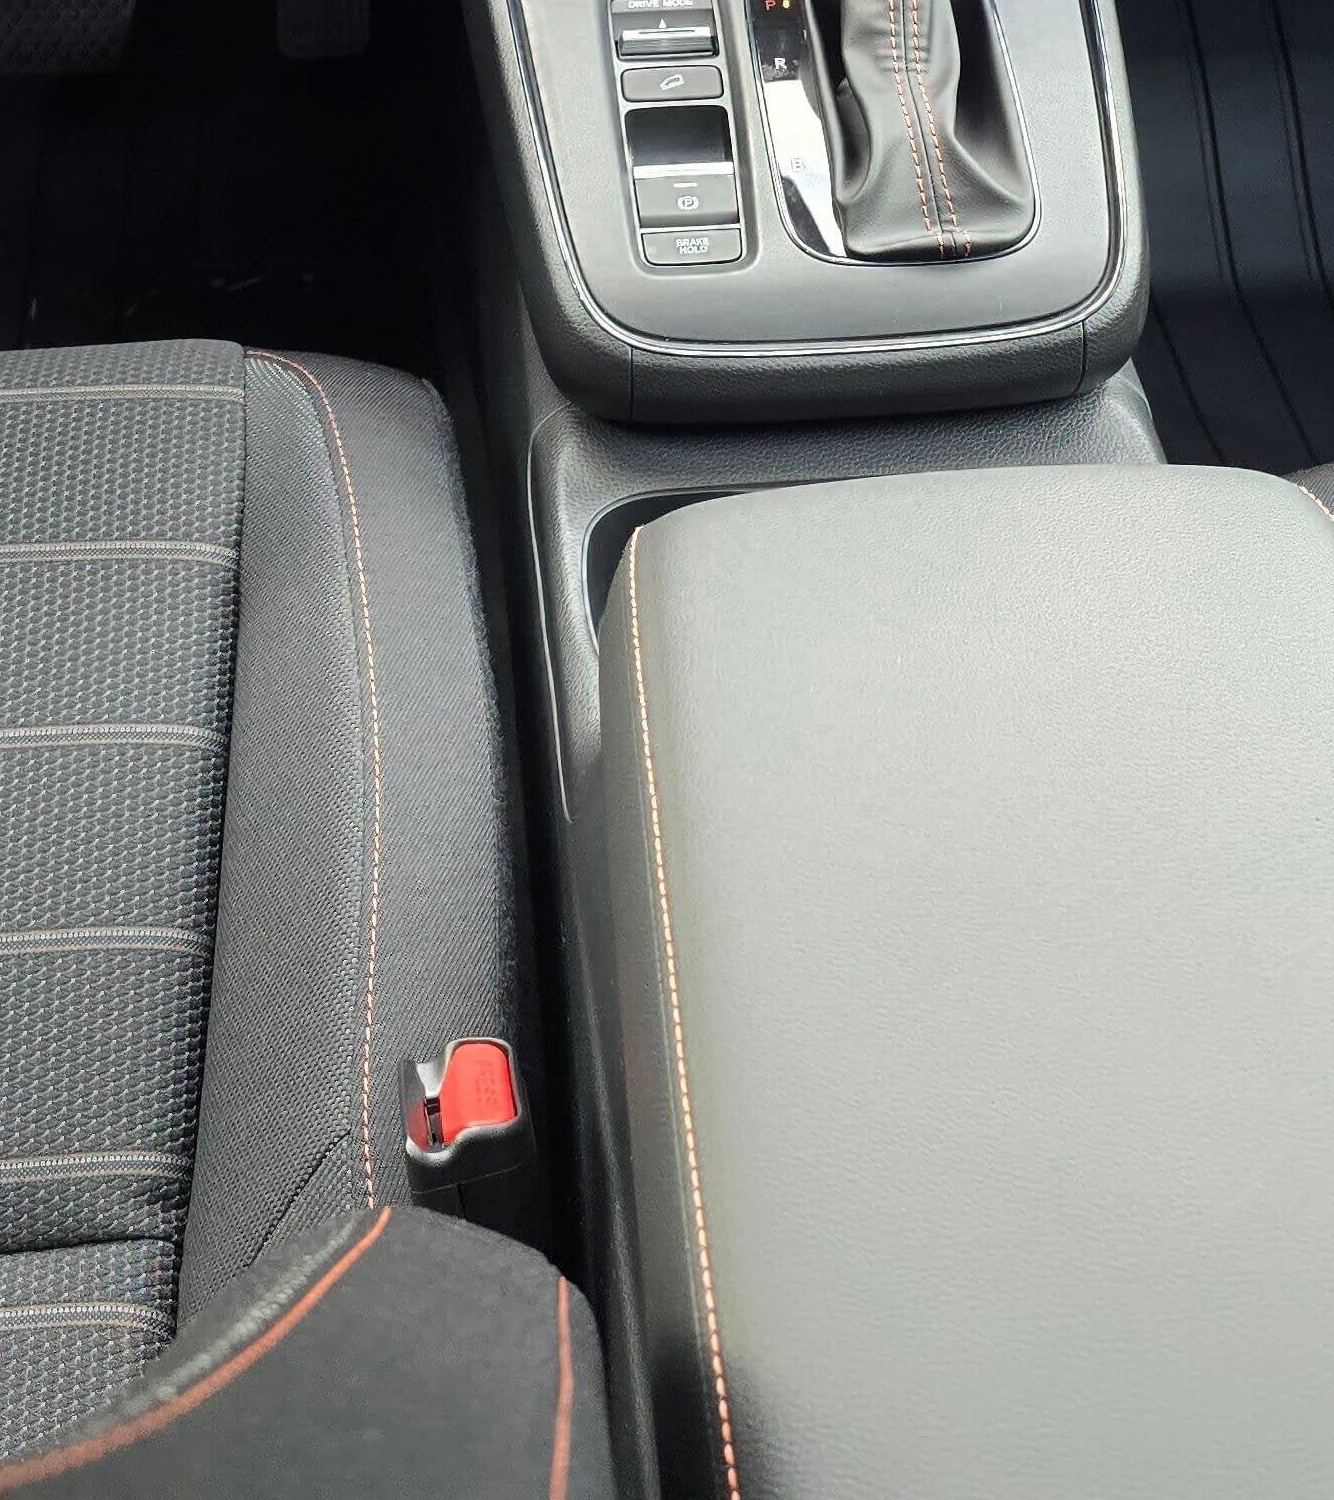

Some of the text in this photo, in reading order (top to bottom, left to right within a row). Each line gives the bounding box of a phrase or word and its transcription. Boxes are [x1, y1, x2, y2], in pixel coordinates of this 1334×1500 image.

[628, 0, 660, 9] DRIVE
[765, 0, 776, 10] P
[774, 57, 787, 70] R
[675, 237, 709, 247] BRAKE
[679, 246, 708, 254] HOLD
